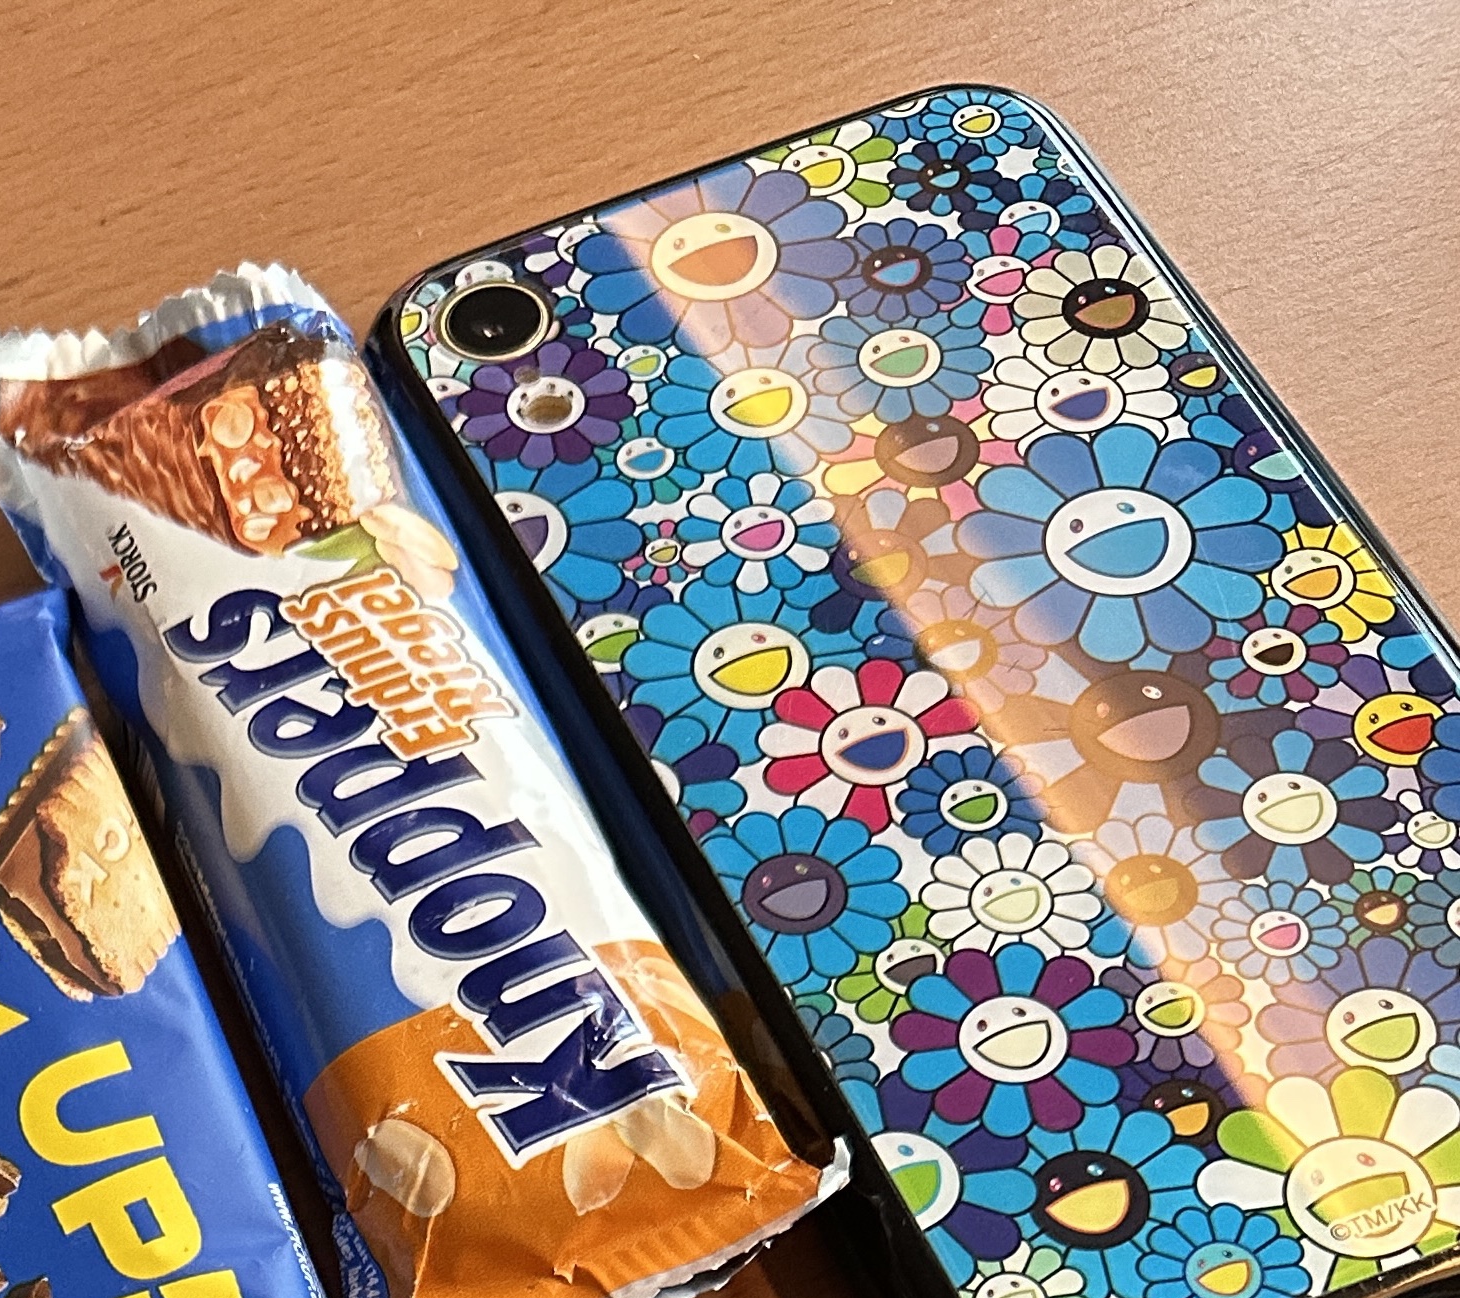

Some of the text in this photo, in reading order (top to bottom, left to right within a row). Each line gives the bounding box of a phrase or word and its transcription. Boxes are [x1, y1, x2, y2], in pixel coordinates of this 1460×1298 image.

[107, 522, 158, 604] STORCK
[284, 591, 472, 757] Erdnuss
[331, 572, 511, 725] Riegel
[164, 588, 684, 1155] Knoppers
